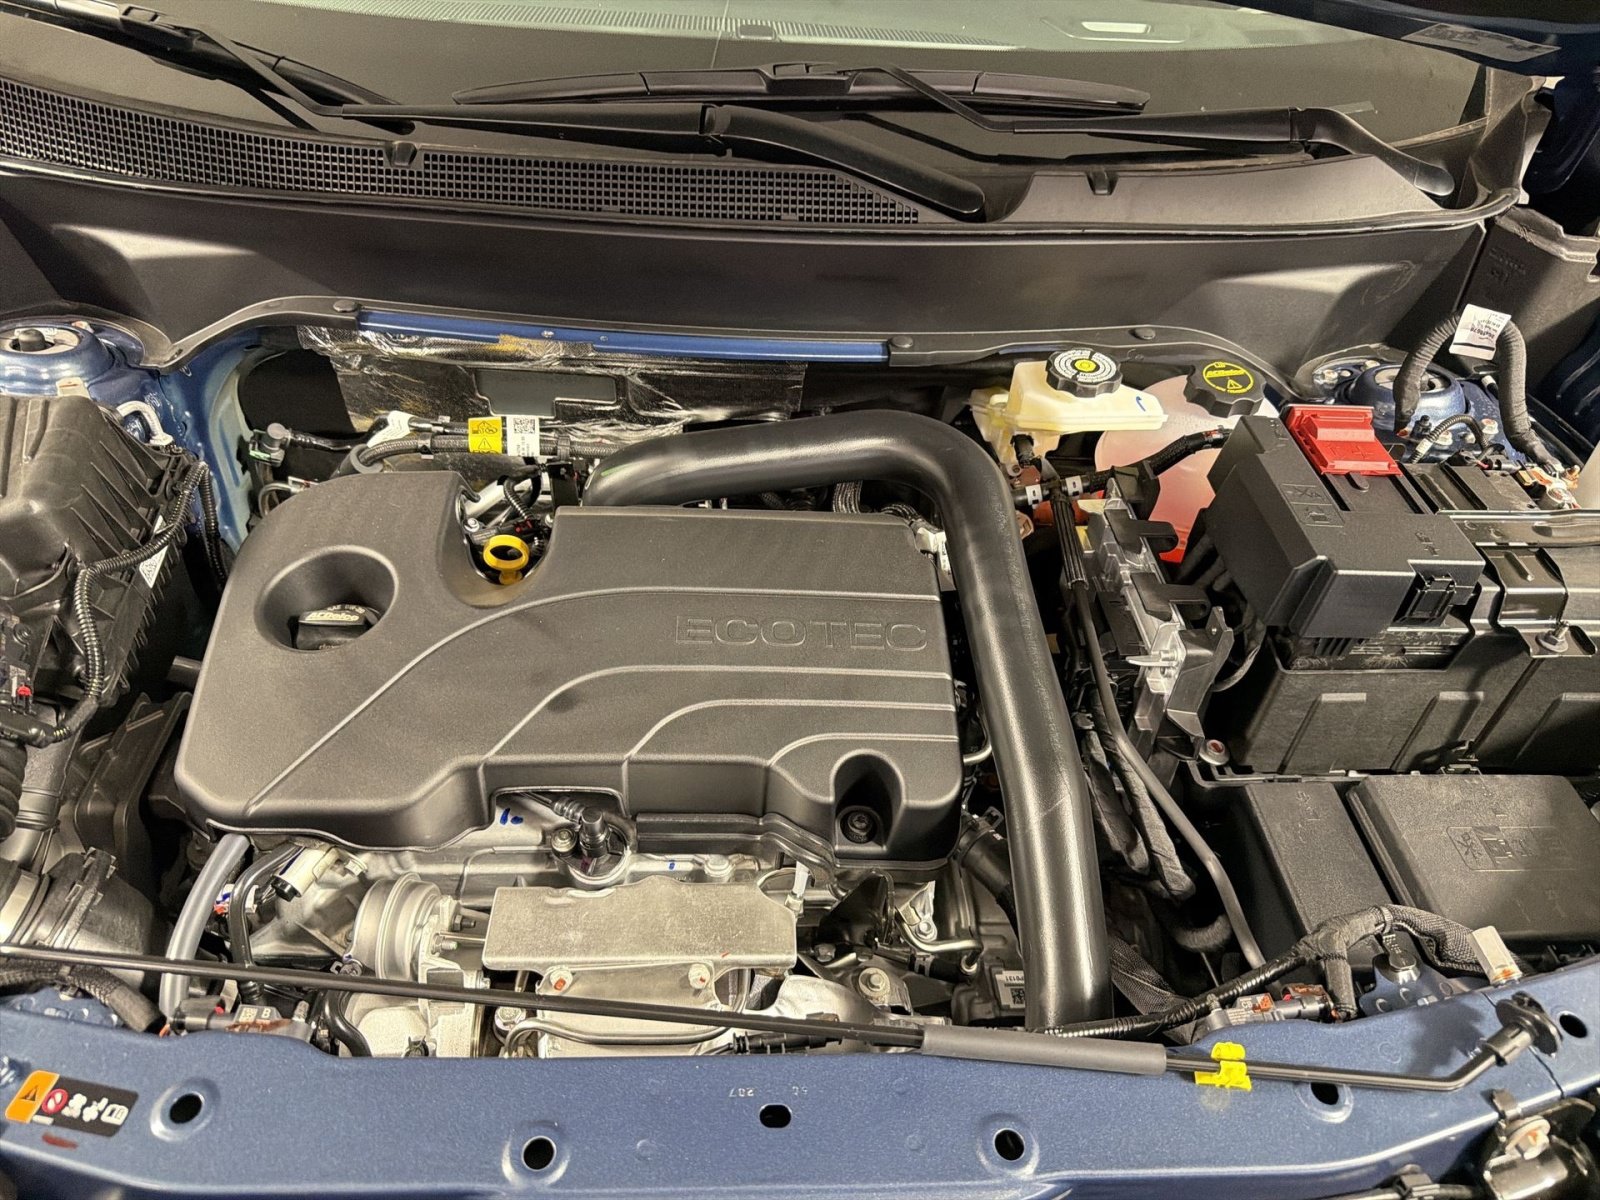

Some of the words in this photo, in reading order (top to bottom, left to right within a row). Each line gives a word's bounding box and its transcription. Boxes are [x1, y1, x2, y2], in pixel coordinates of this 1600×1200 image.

[305, 611, 360, 622] ACDelco
[676, 615, 928, 651] ECOTEC
[261, 1007, 272, 1019] B
